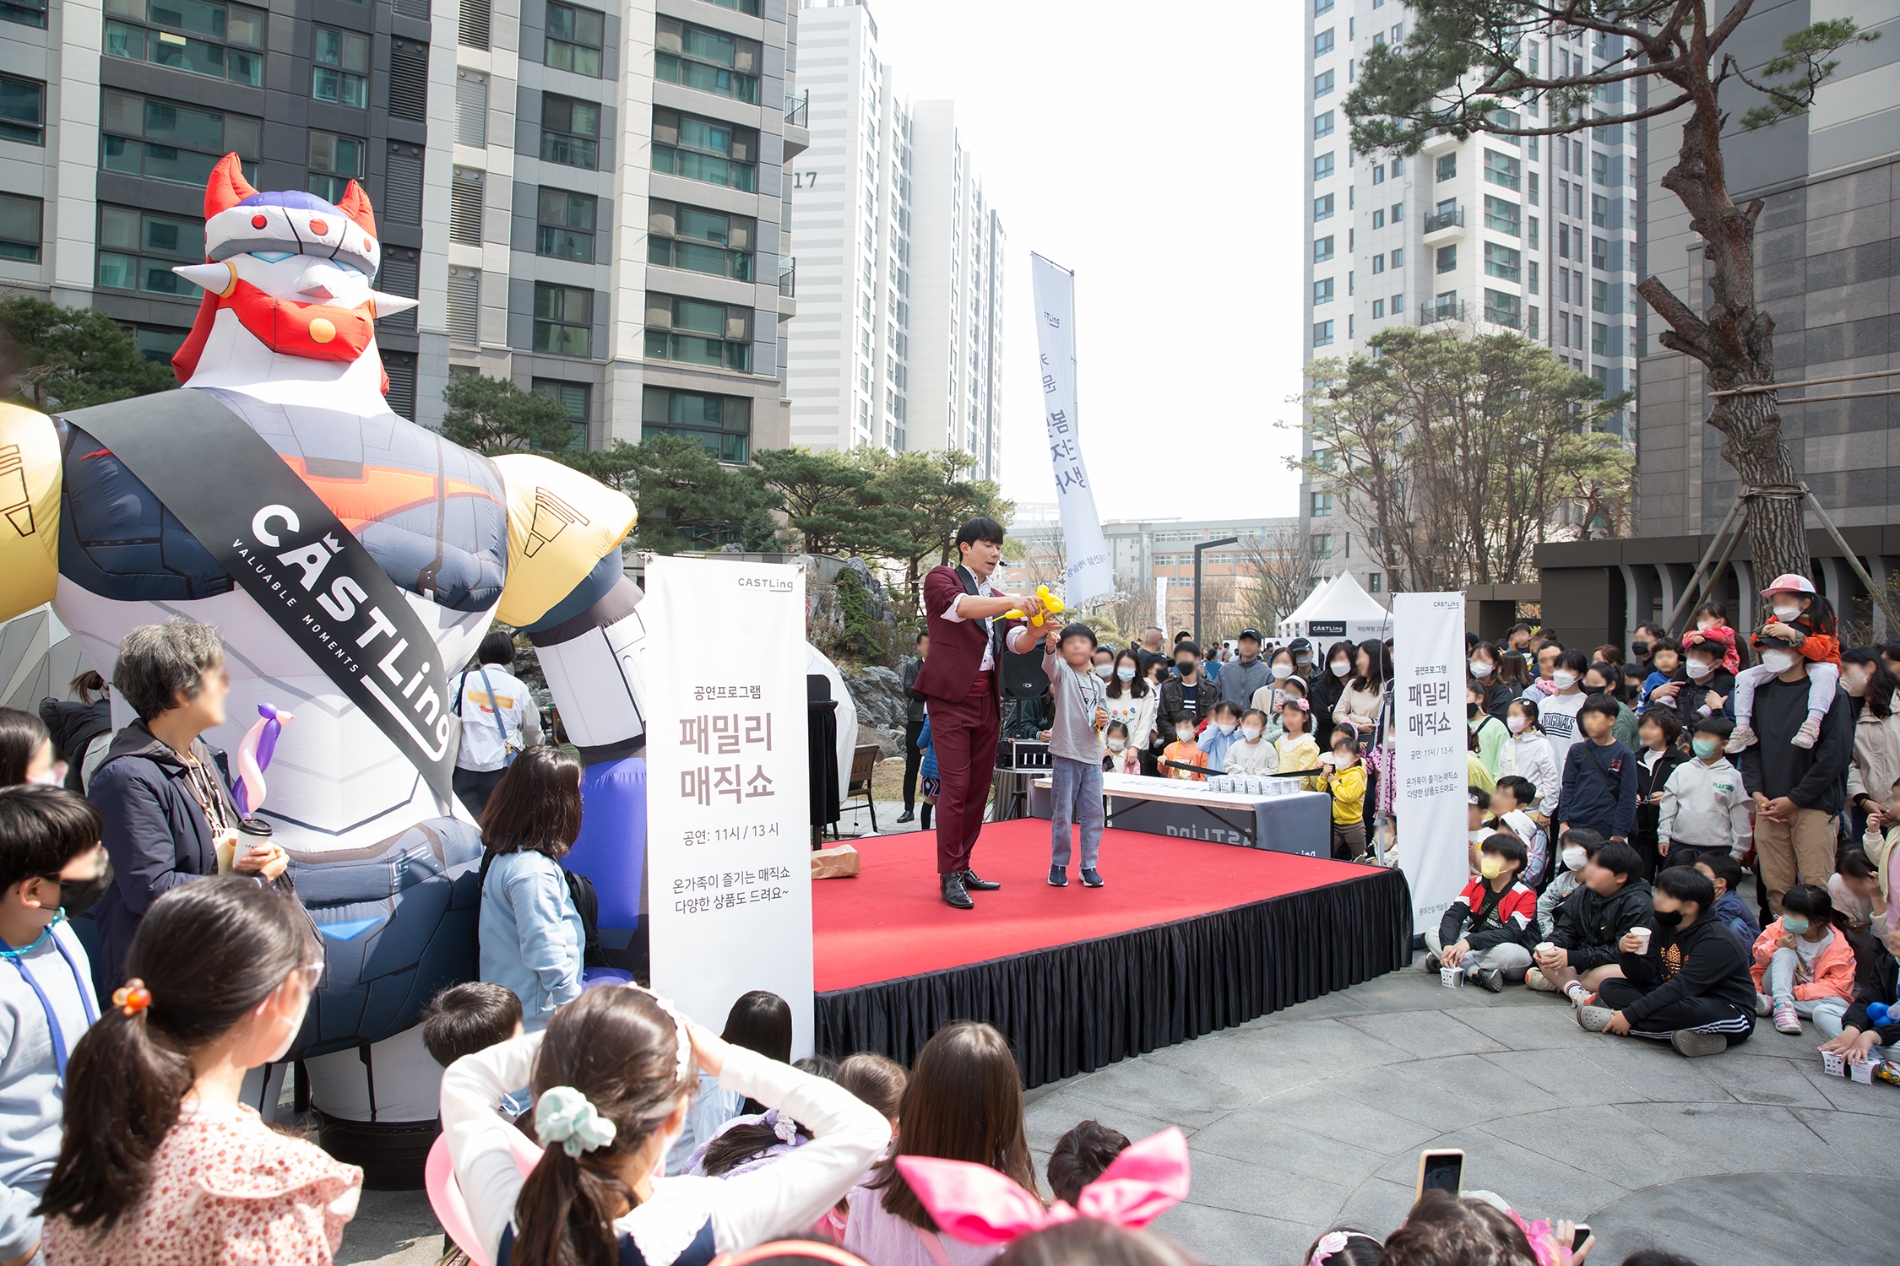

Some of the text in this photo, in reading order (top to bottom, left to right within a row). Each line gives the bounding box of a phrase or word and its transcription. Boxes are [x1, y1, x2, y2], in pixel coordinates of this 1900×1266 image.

[794, 171, 817, 188] 17
[738, 577, 793, 593] CASTLing
[231, 538, 359, 674] VALUABLE MOMENTS
[251, 504, 450, 762] CASTLing
[1414, 665, 1447, 676] 공연프로그램
[693, 684, 762, 702] 공연프로그램
[1408, 681, 1450, 707] 패밀리
[679, 712, 772, 755] 패밀리
[1409, 711, 1452, 737] 매직쇼
[680, 763, 775, 806] 매직쇼
[682, 829, 710, 847] 공연:
[715, 825, 740, 841] 11시
[672, 866, 791, 895] 온가족이 즐기는 매직쇼
[674, 886, 790, 915] 다양한 상품도 드려요~
